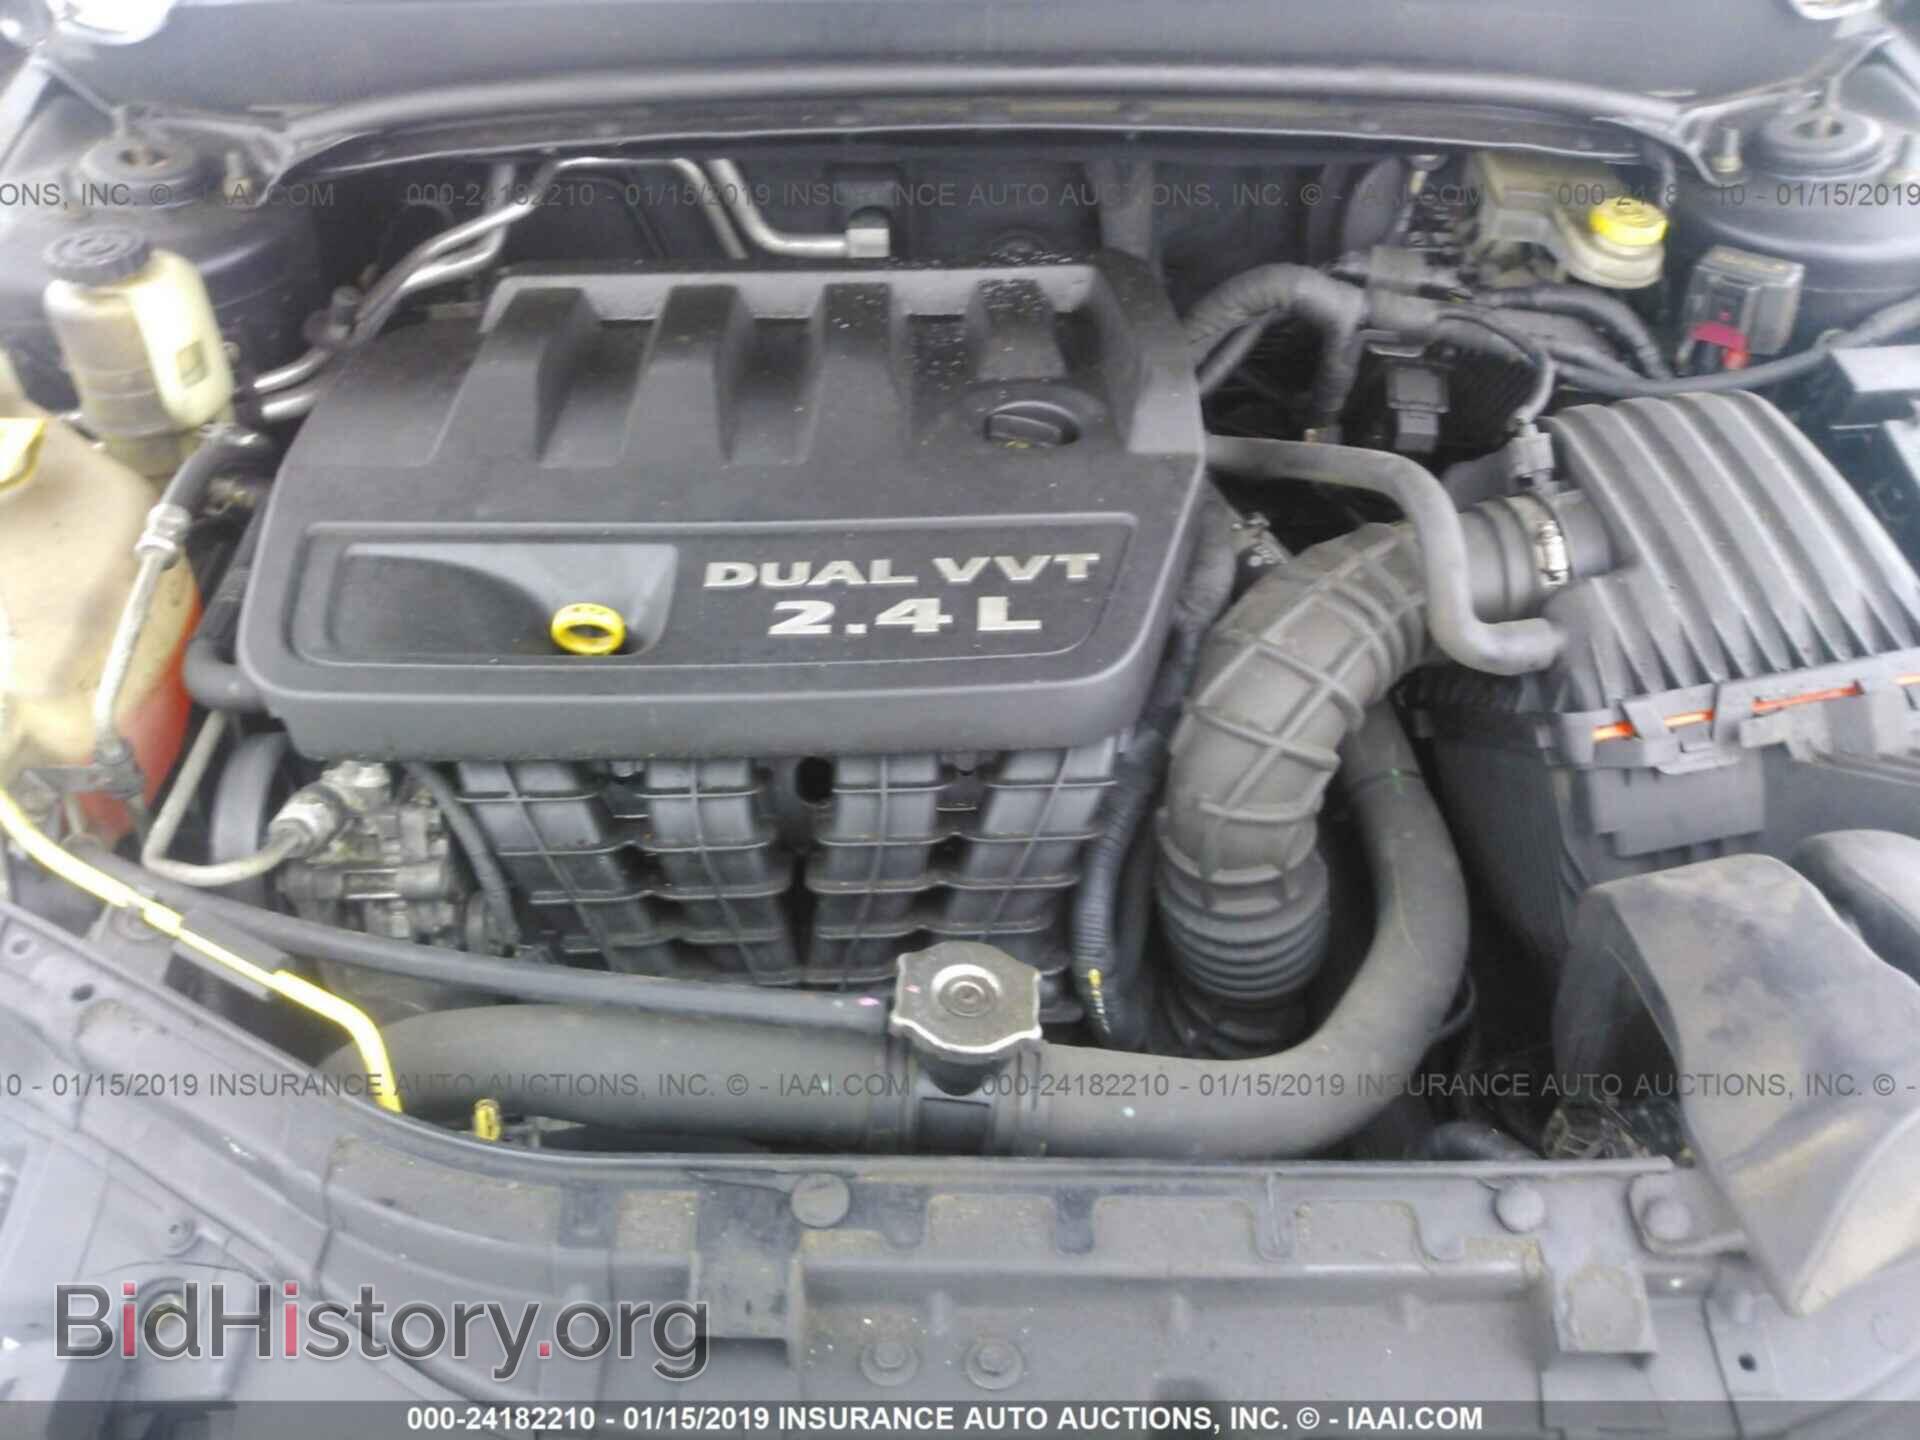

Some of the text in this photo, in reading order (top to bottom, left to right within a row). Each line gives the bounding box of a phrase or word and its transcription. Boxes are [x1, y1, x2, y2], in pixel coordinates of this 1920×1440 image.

[703, 553, 1100, 588] DUAL VVT
[767, 595, 1042, 636] 2.4 L
